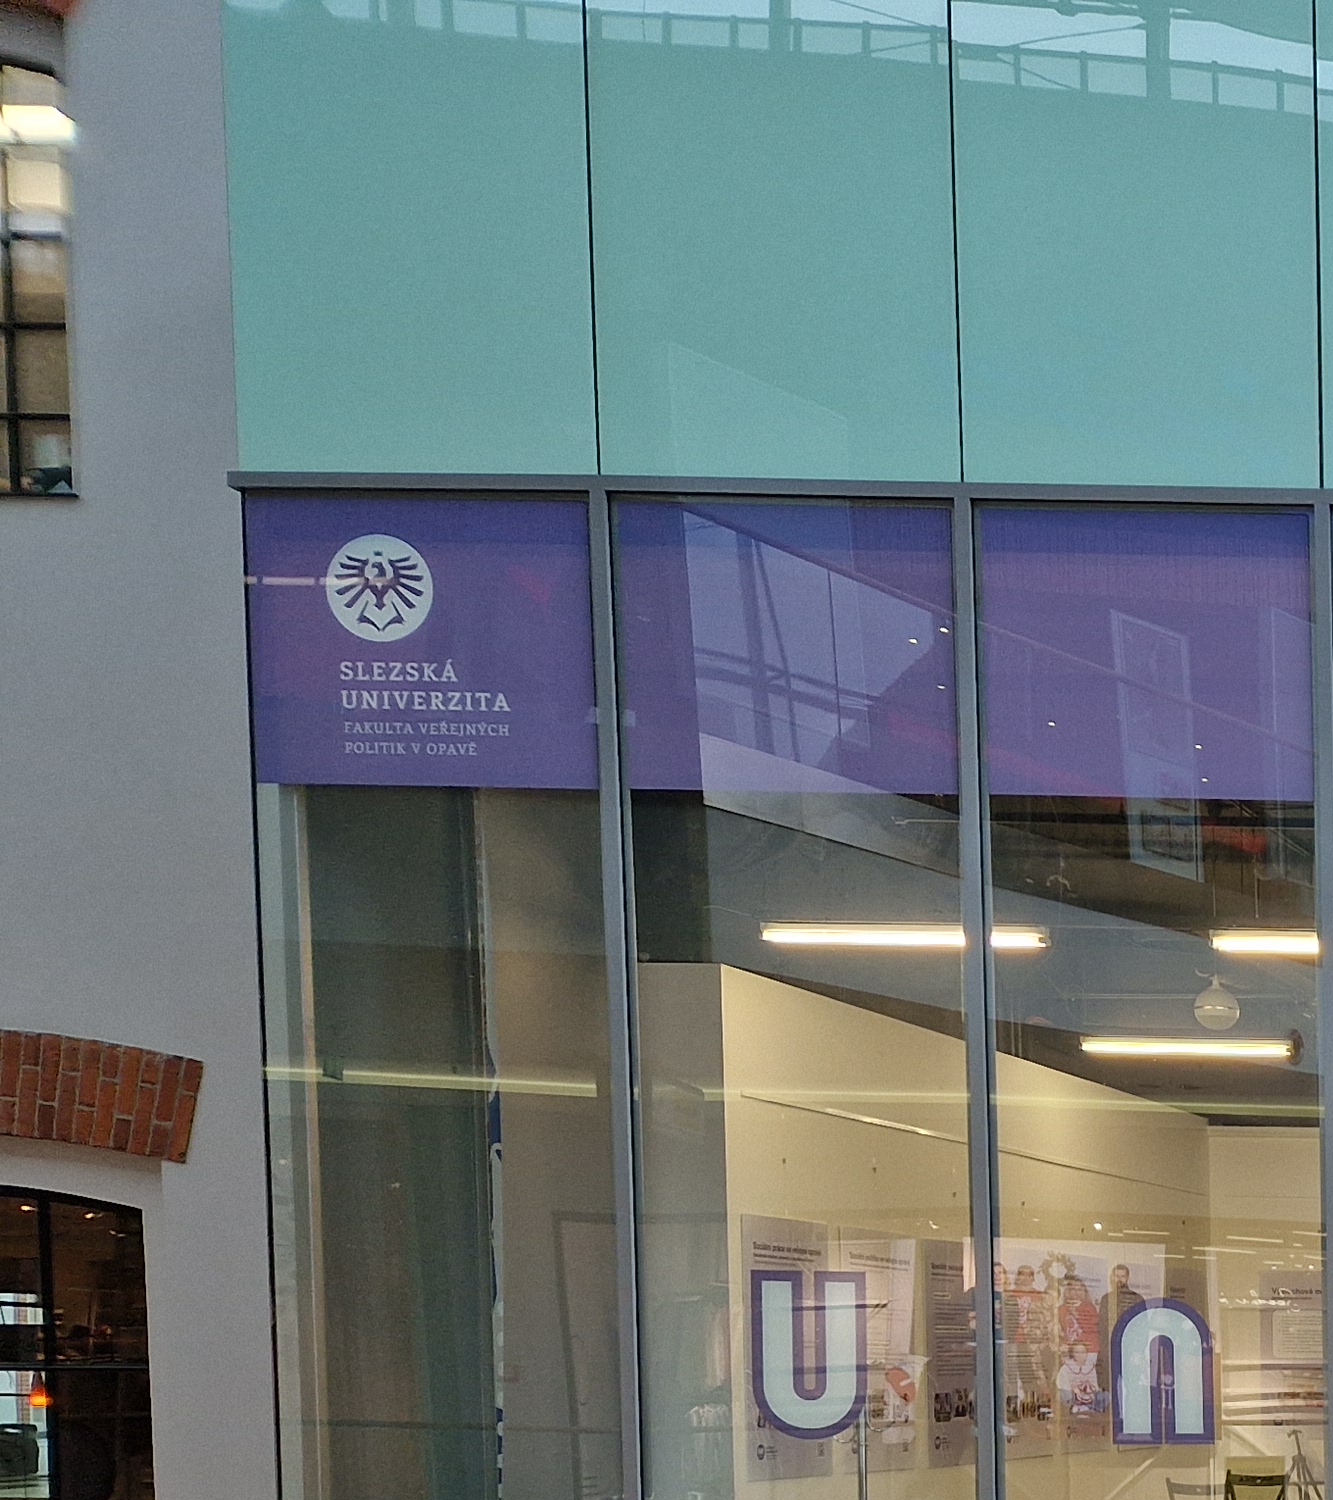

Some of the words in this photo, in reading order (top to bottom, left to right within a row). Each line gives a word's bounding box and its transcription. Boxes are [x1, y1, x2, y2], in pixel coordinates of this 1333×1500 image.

[340, 659, 459, 682] SLEZSKÁ
[341, 690, 511, 712] UNIVERZITA
[344, 721, 414, 735] FAKULTA
[418, 722, 510, 737] VEŘEJNÝCH
[345, 741, 406, 755] POLITIK
[411, 742, 423, 755] V
[427, 742, 478, 756] OPAVĚ
